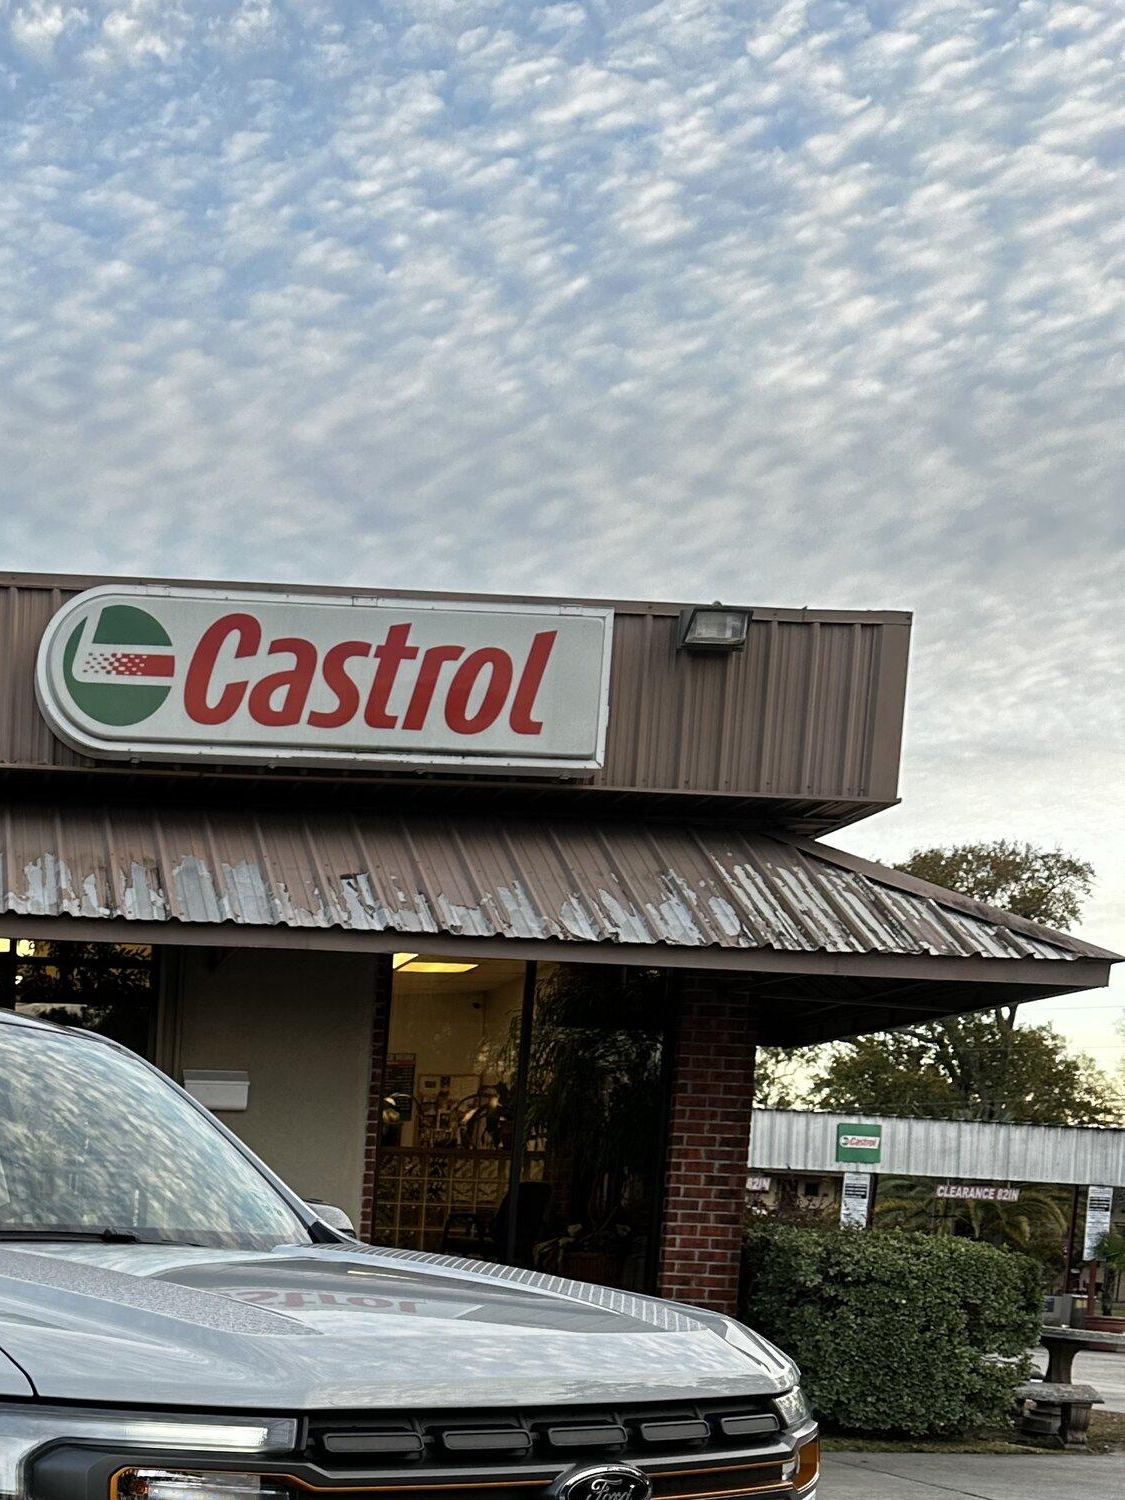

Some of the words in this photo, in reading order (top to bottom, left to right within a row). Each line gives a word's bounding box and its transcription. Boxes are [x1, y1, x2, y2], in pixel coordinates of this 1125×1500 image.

[183, 612, 558, 736] Castrol
[937, 1185, 996, 1200] CLEARANCE
[997, 1188, 1020, 1202] 82IN
